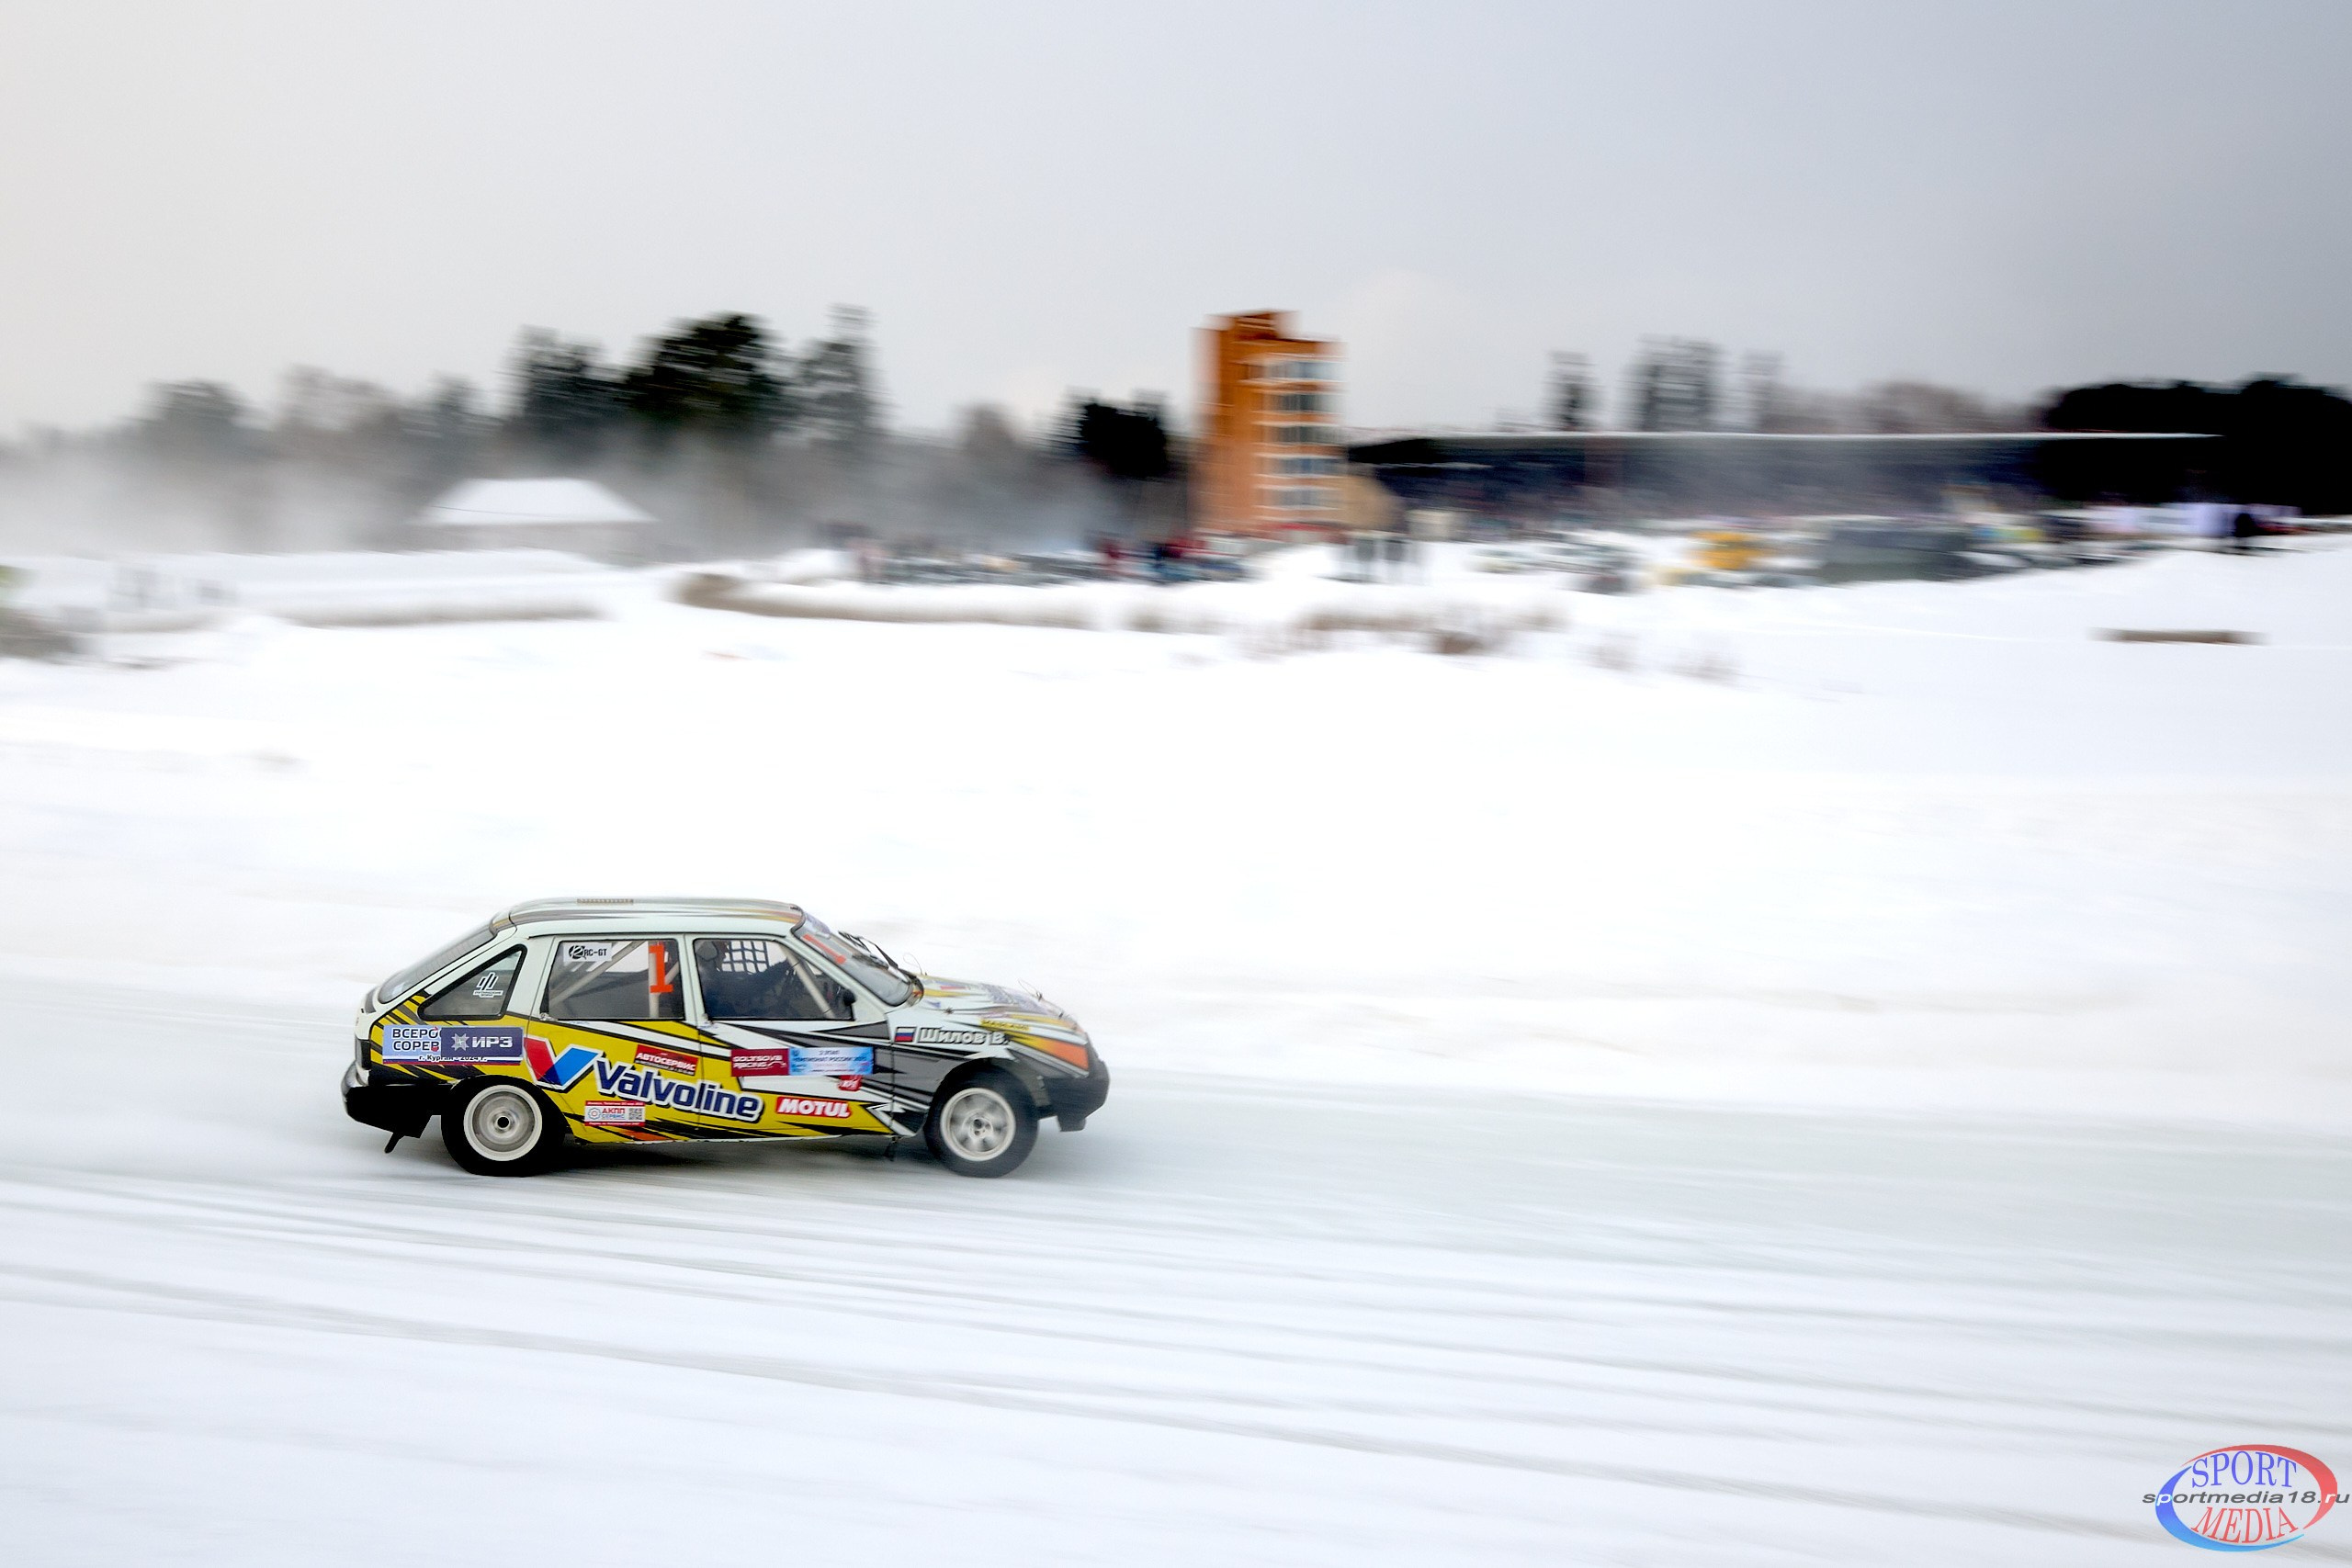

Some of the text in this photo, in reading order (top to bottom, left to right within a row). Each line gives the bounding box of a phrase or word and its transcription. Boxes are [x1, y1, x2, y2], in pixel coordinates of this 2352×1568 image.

[649, 942, 673, 993] 1
[392, 1028, 441, 1039] ВСЕРО
[471, 1036, 513, 1048] ИРЗ
[918, 1027, 987, 1044] Шилов
[636, 1053, 696, 1071] АВТОСЕРВИС
[596, 1060, 762, 1119] Valvoline
[777, 1098, 850, 1117] MOTUL
